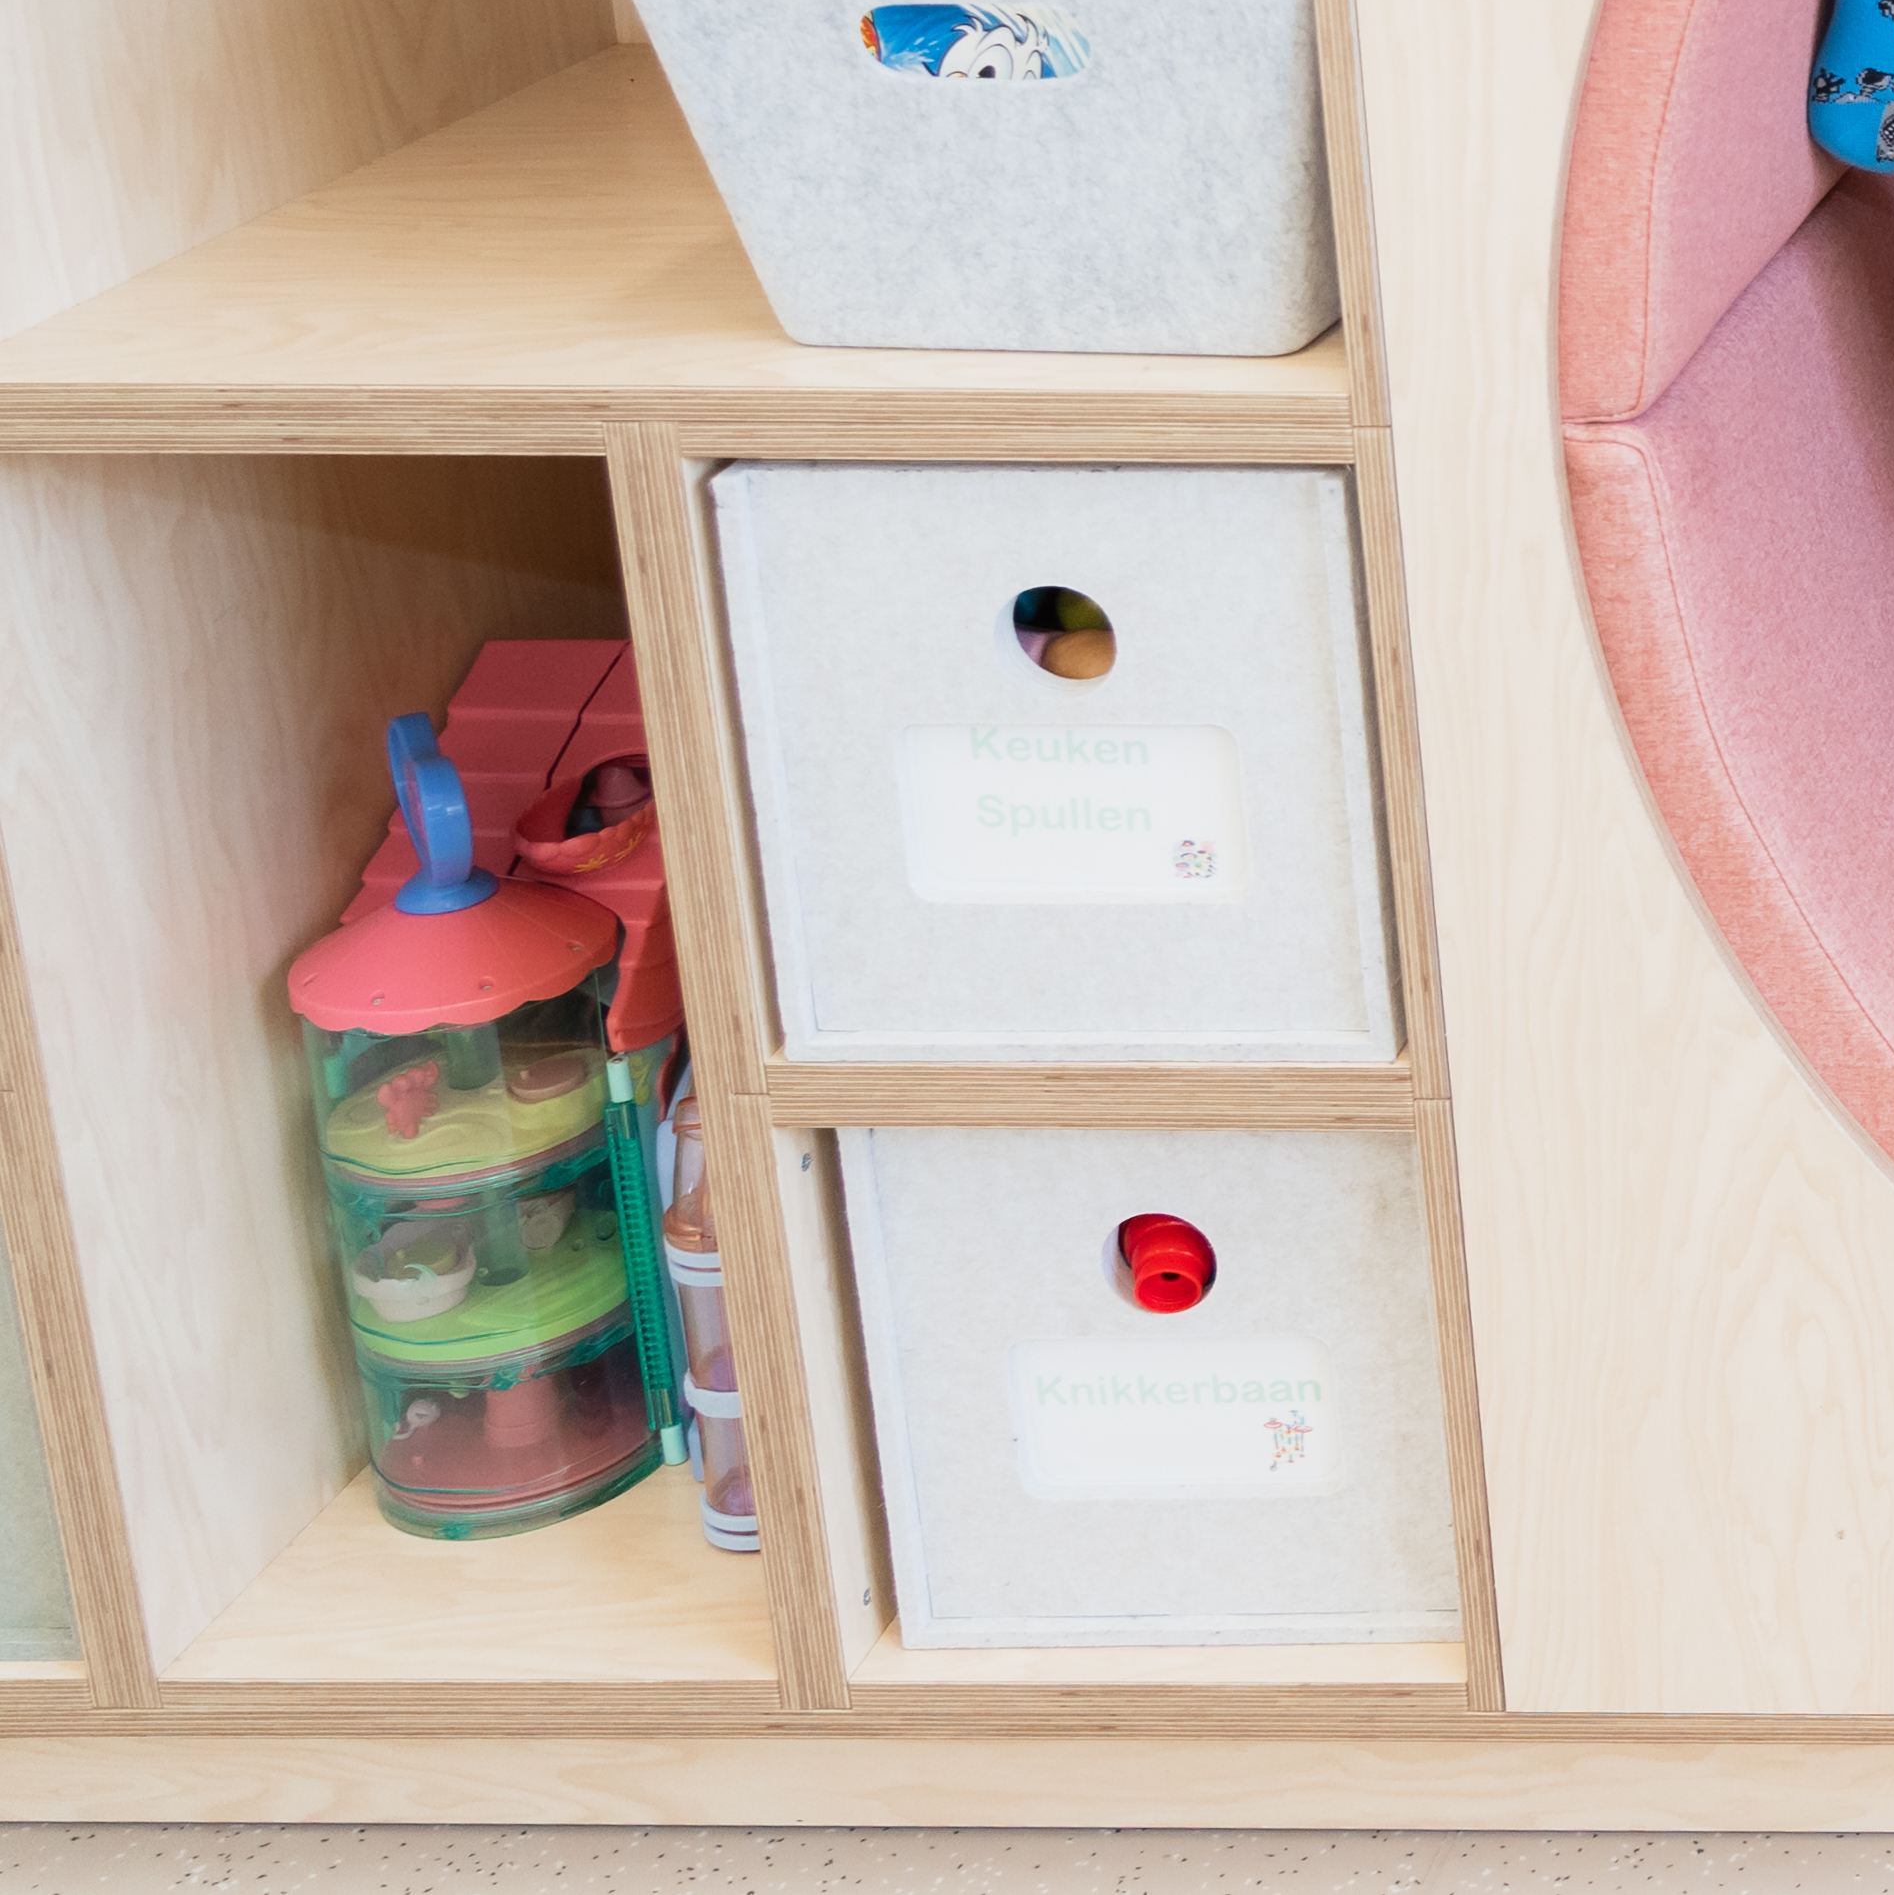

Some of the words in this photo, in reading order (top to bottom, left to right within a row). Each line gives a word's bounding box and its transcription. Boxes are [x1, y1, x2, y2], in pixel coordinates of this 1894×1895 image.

[969, 727, 1149, 765] Keuken
[976, 794, 1152, 837] Spullen
[1036, 1373, 1322, 1405] Knikkerbaan
